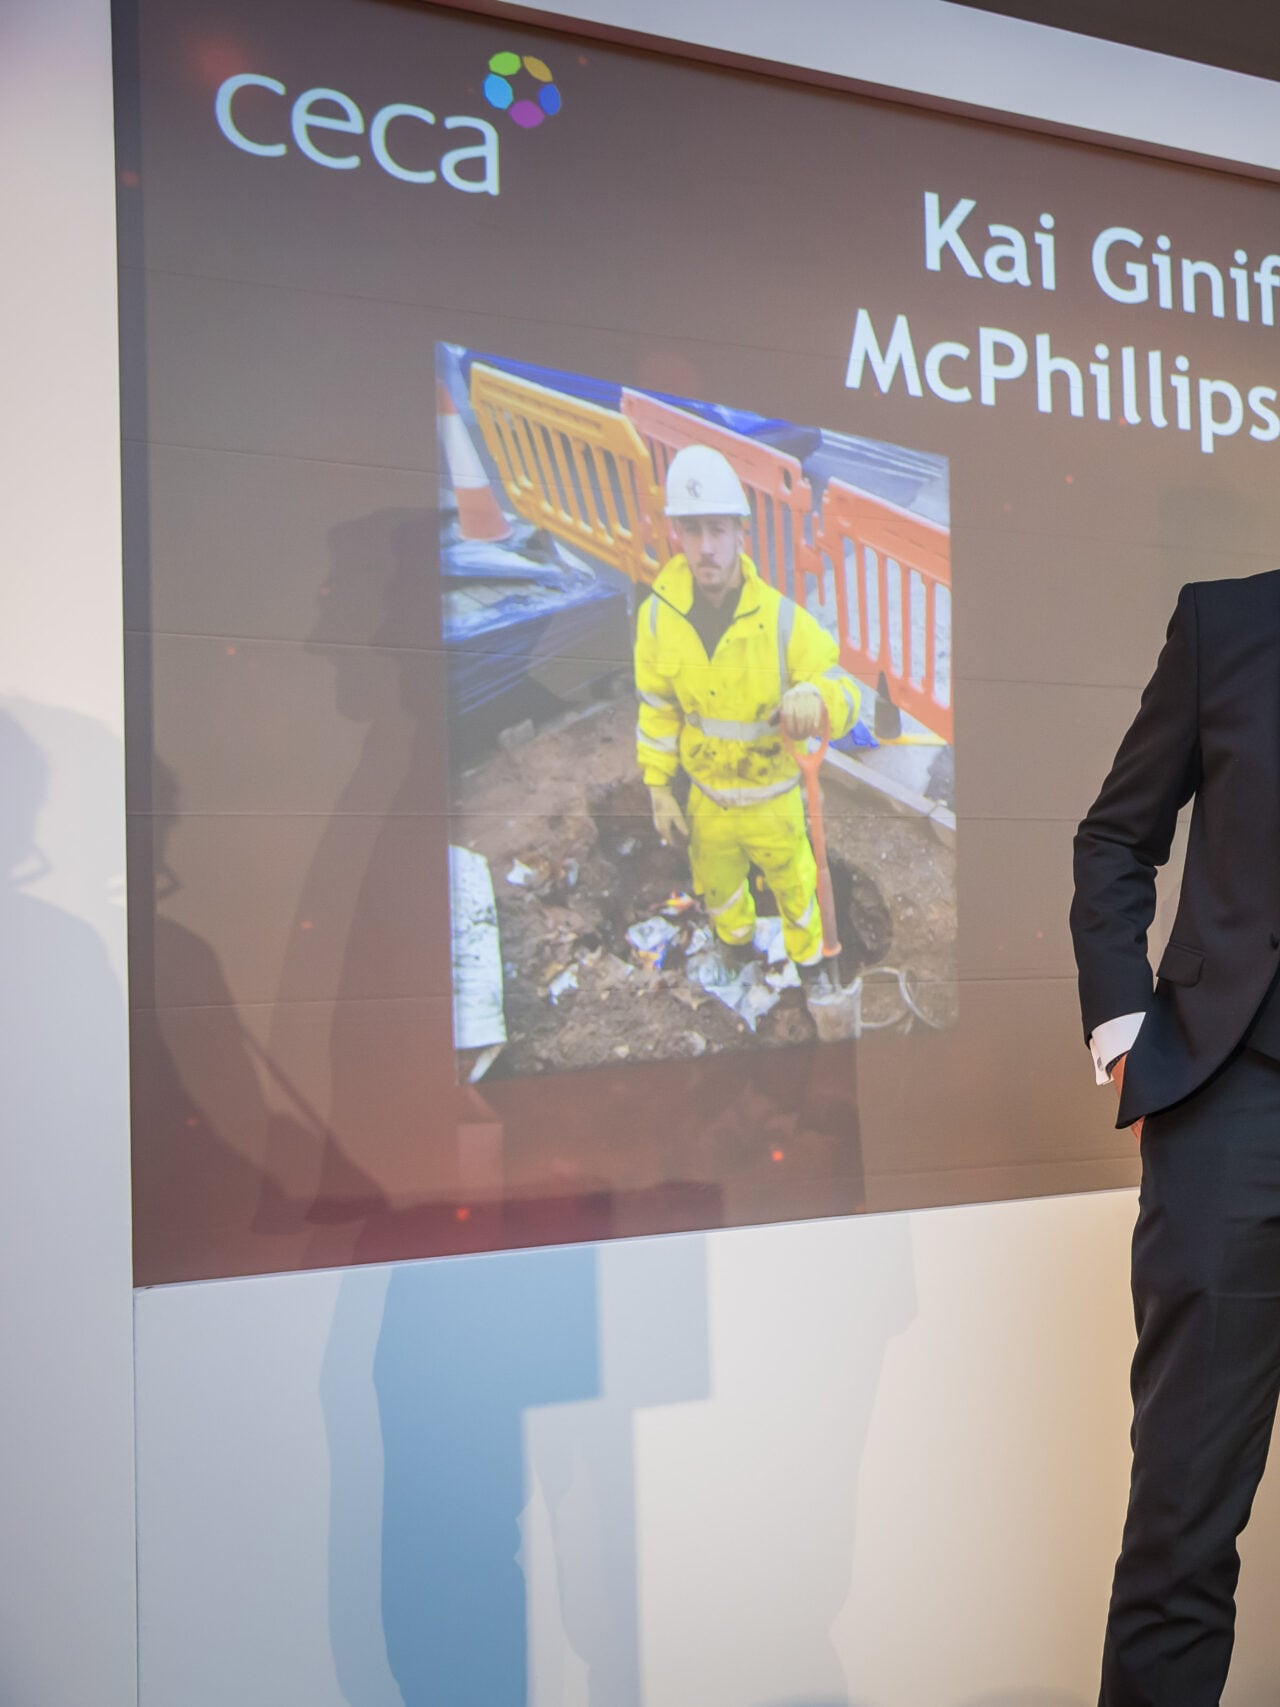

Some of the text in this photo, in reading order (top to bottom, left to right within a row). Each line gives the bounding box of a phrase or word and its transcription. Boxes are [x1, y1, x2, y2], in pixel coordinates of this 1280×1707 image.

[214, 73, 499, 196] ceca
[924, 191, 1056, 290] Kai
[844, 308, 1280, 453] McPhillips
